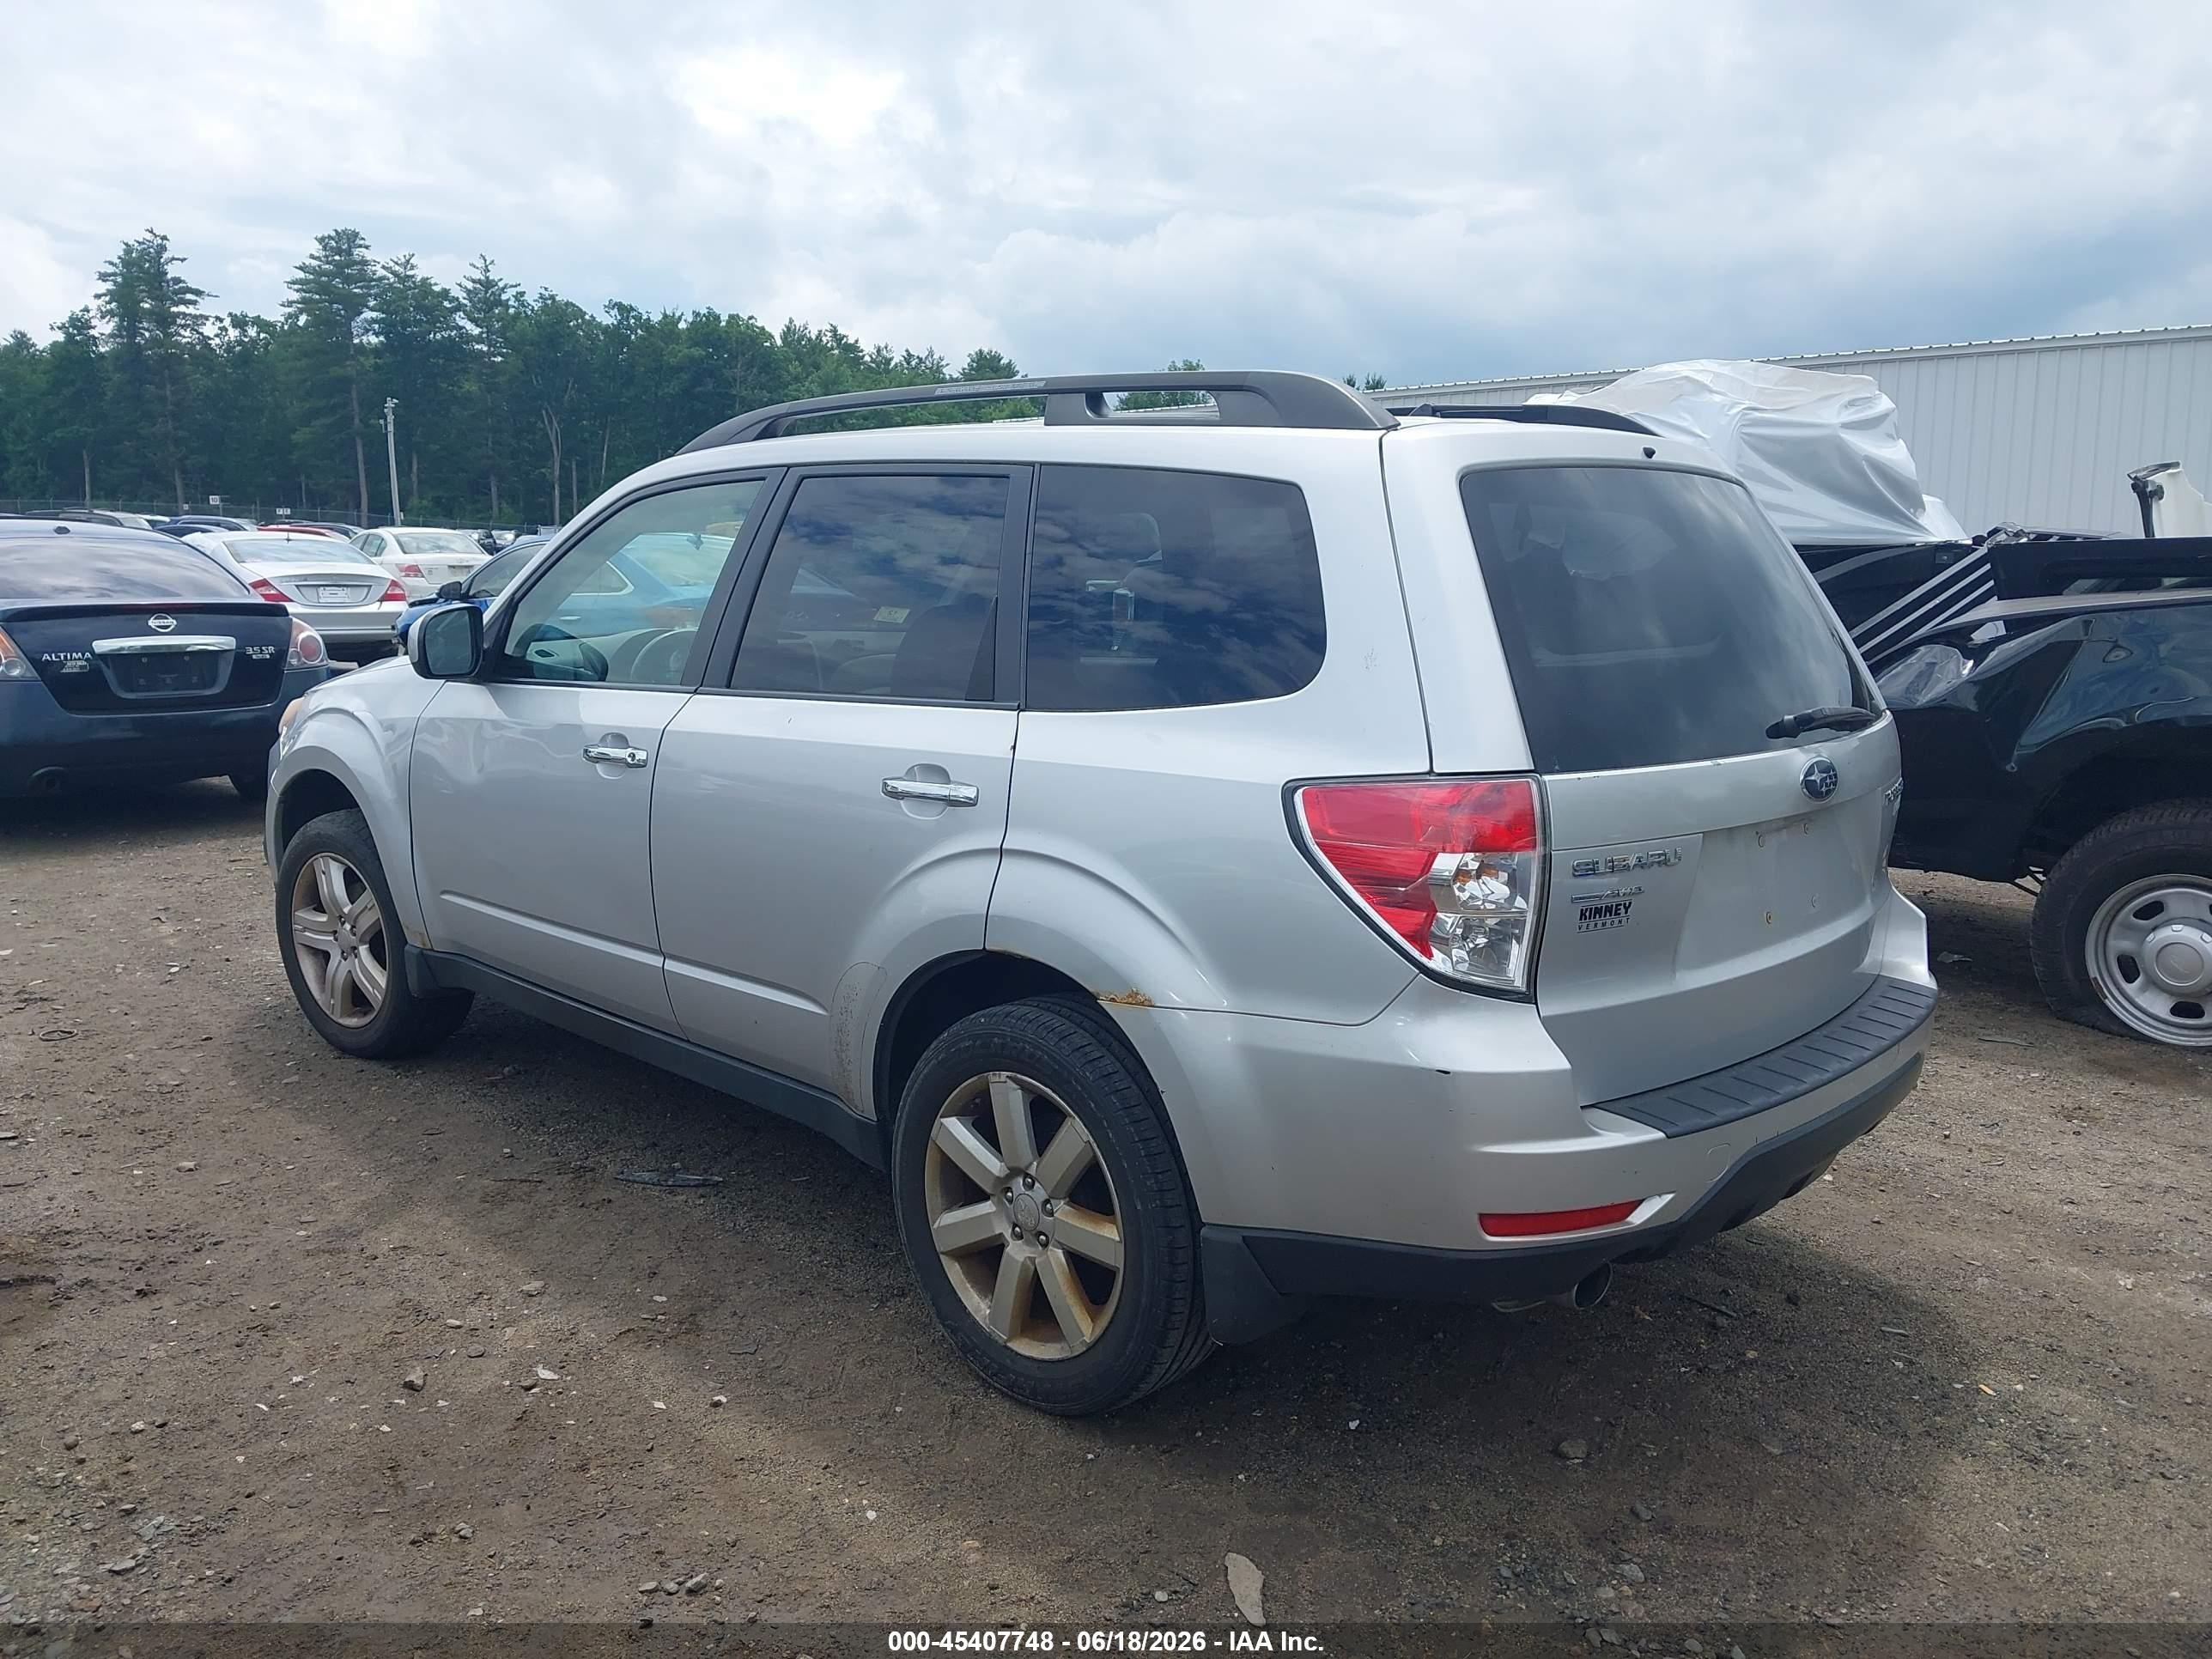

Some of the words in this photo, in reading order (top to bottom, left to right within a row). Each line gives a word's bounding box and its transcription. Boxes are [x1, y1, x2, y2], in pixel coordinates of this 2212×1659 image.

[41, 652, 93, 661] ALTIMA
[1571, 848, 1682, 877] SUBARU
[1579, 901, 1632, 922] KINNEY
[1577, 917, 1631, 931] VERMONT
